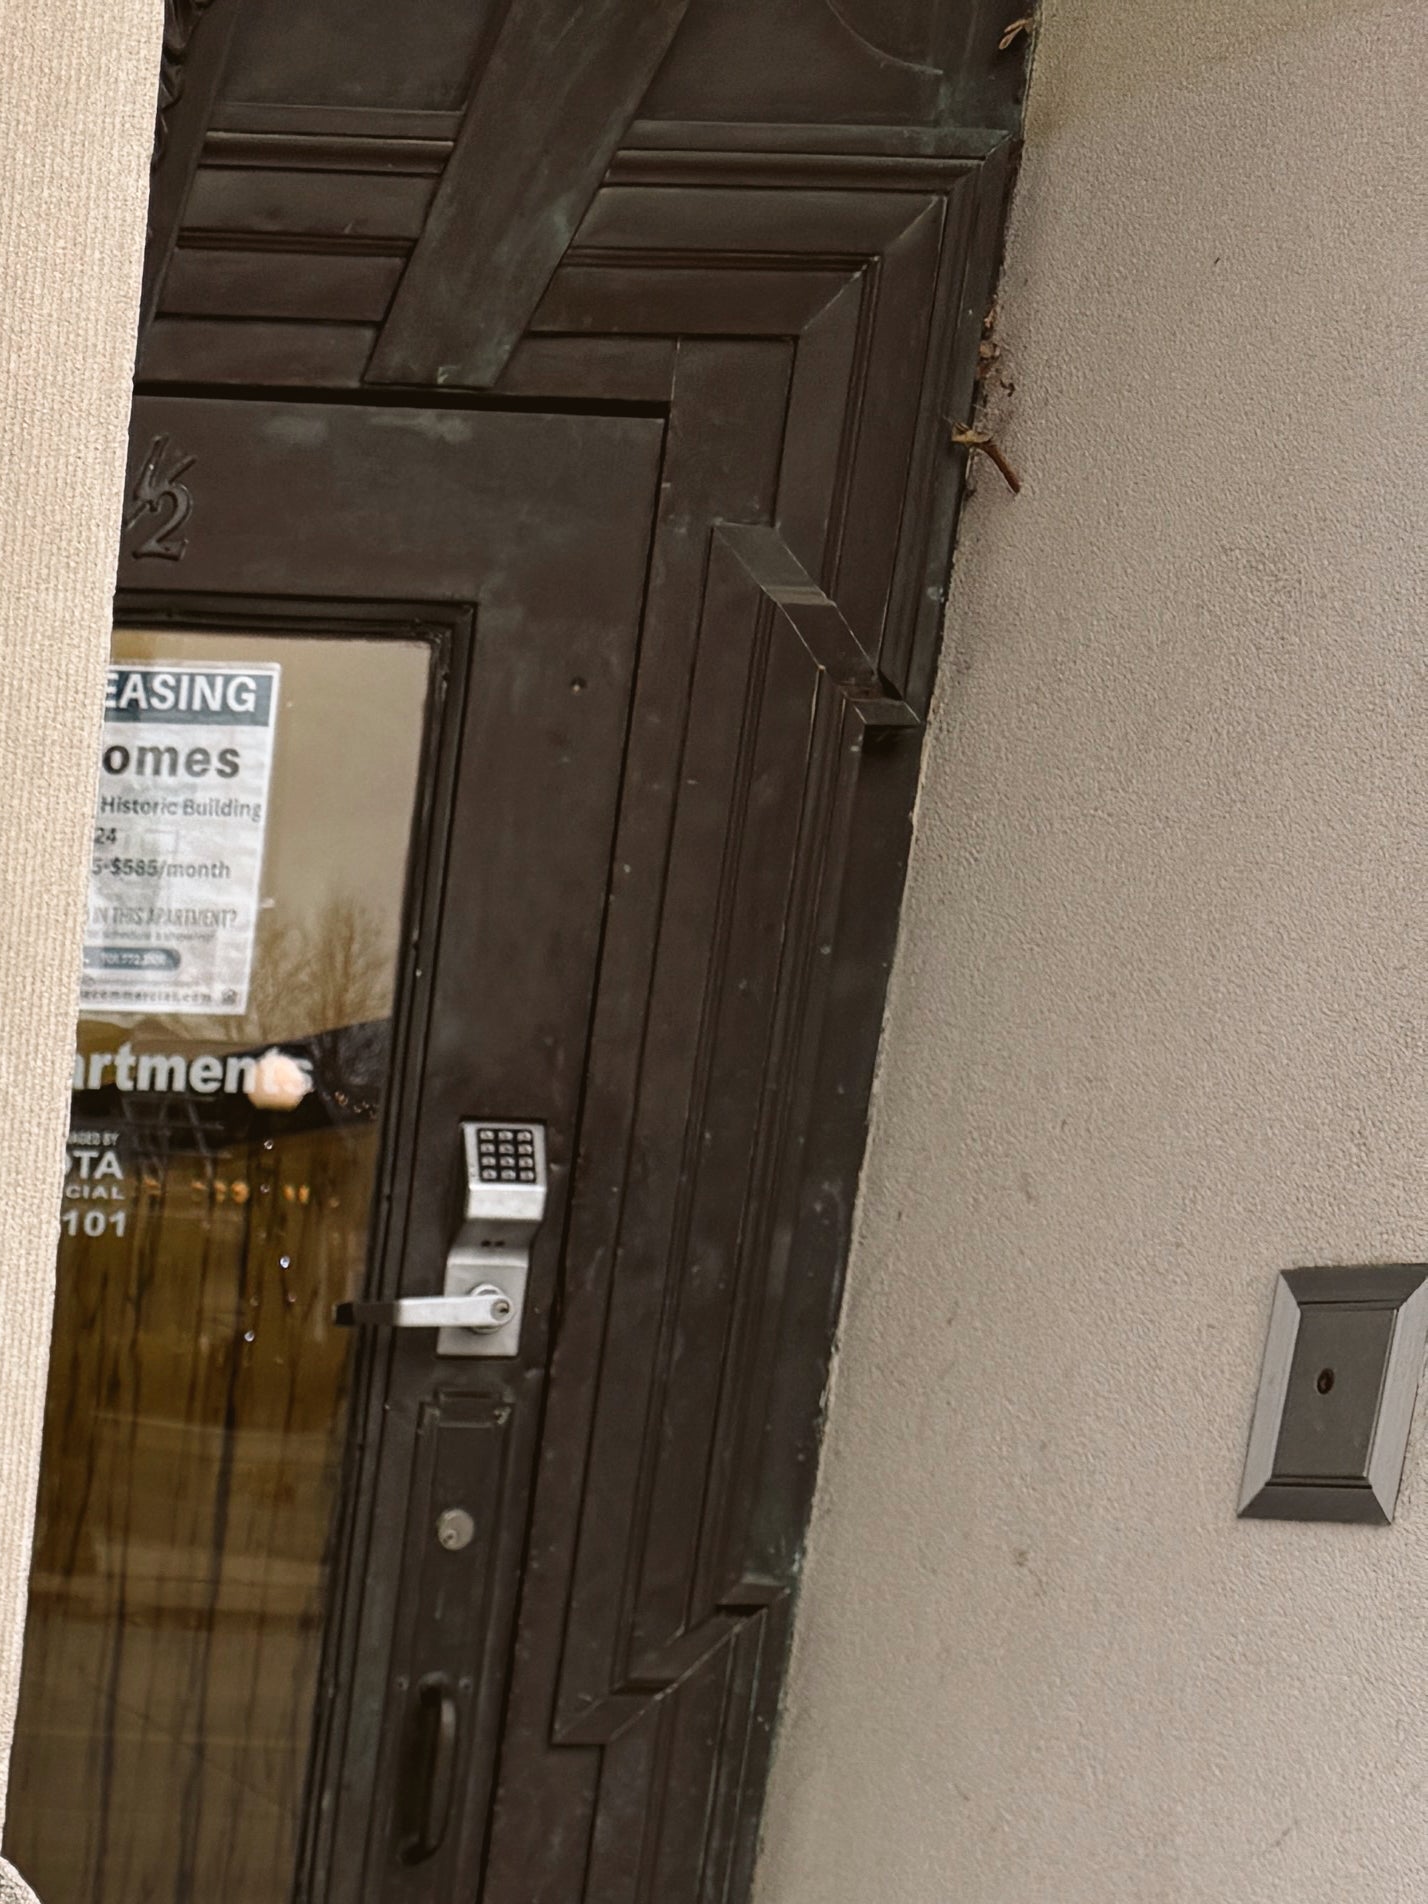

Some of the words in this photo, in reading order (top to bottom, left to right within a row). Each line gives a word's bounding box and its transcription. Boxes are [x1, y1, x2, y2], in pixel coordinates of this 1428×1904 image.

[102, 744, 241, 779] omes
[100, 796, 178, 816] Historic
[182, 798, 262, 823] Building
[94, 827, 117, 845] 24
[112, 906, 143, 926] THIS
[64, 1150, 123, 1180] TA
[65, 1184, 125, 1200] CIAL
[62, 1209, 127, 1238] 101
